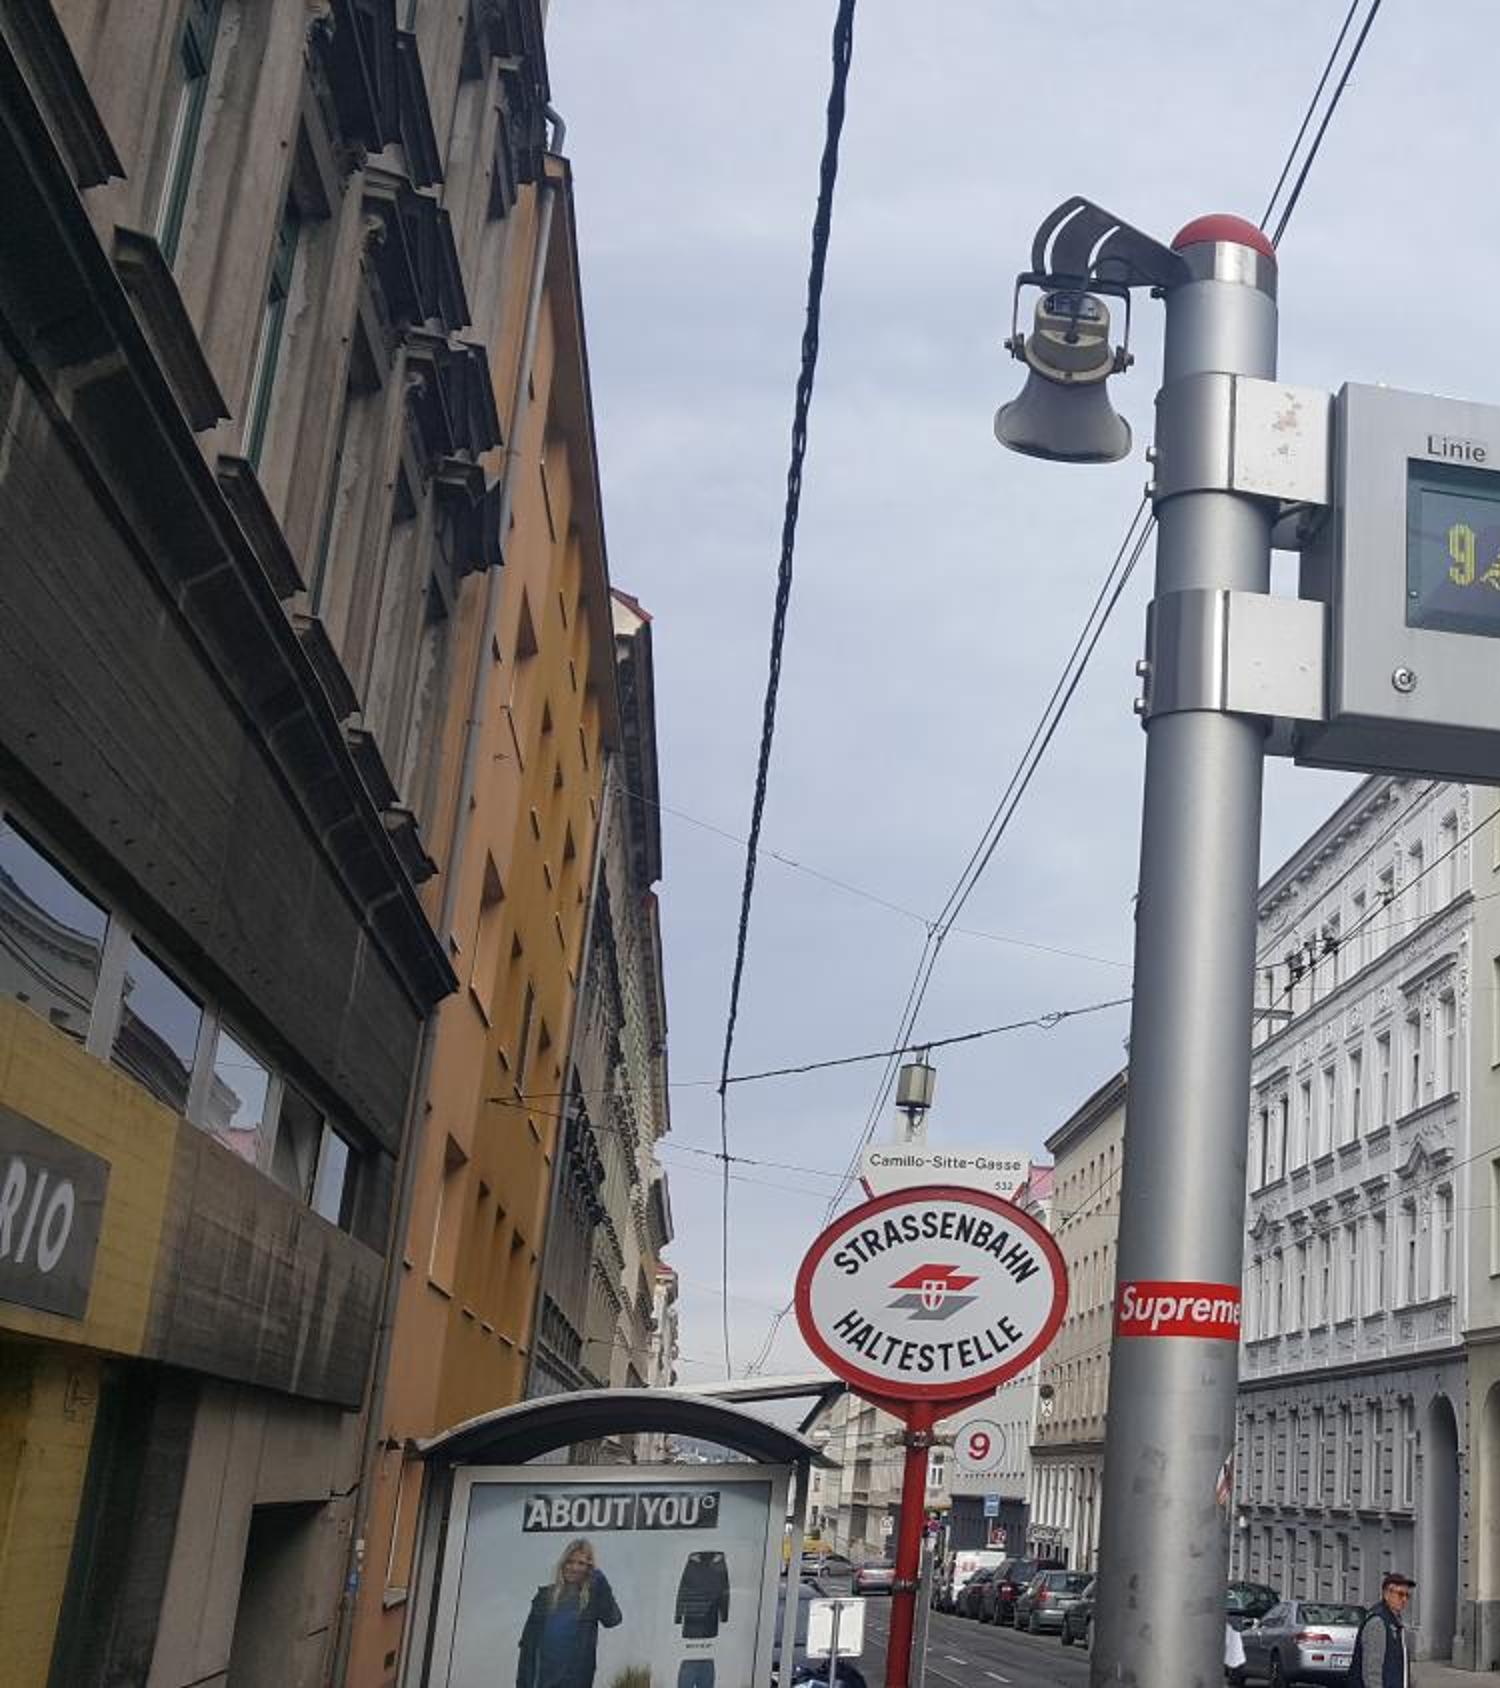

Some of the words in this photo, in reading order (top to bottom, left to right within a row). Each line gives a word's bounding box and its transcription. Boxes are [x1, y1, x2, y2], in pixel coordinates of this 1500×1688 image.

[1427, 436, 1487, 463] Linie
[1448, 523, 1476, 586] 9
[869, 1153, 1022, 1171] Camillo-Sitte-Gasse
[995, 1181, 1013, 1191] 532
[833, 1211, 1040, 1284] STRASSENBAHN
[833, 1309, 1023, 1373] HALTESTELLE
[968, 1432, 991, 1461] 9
[526, 1497, 631, 1529] ABOUT
